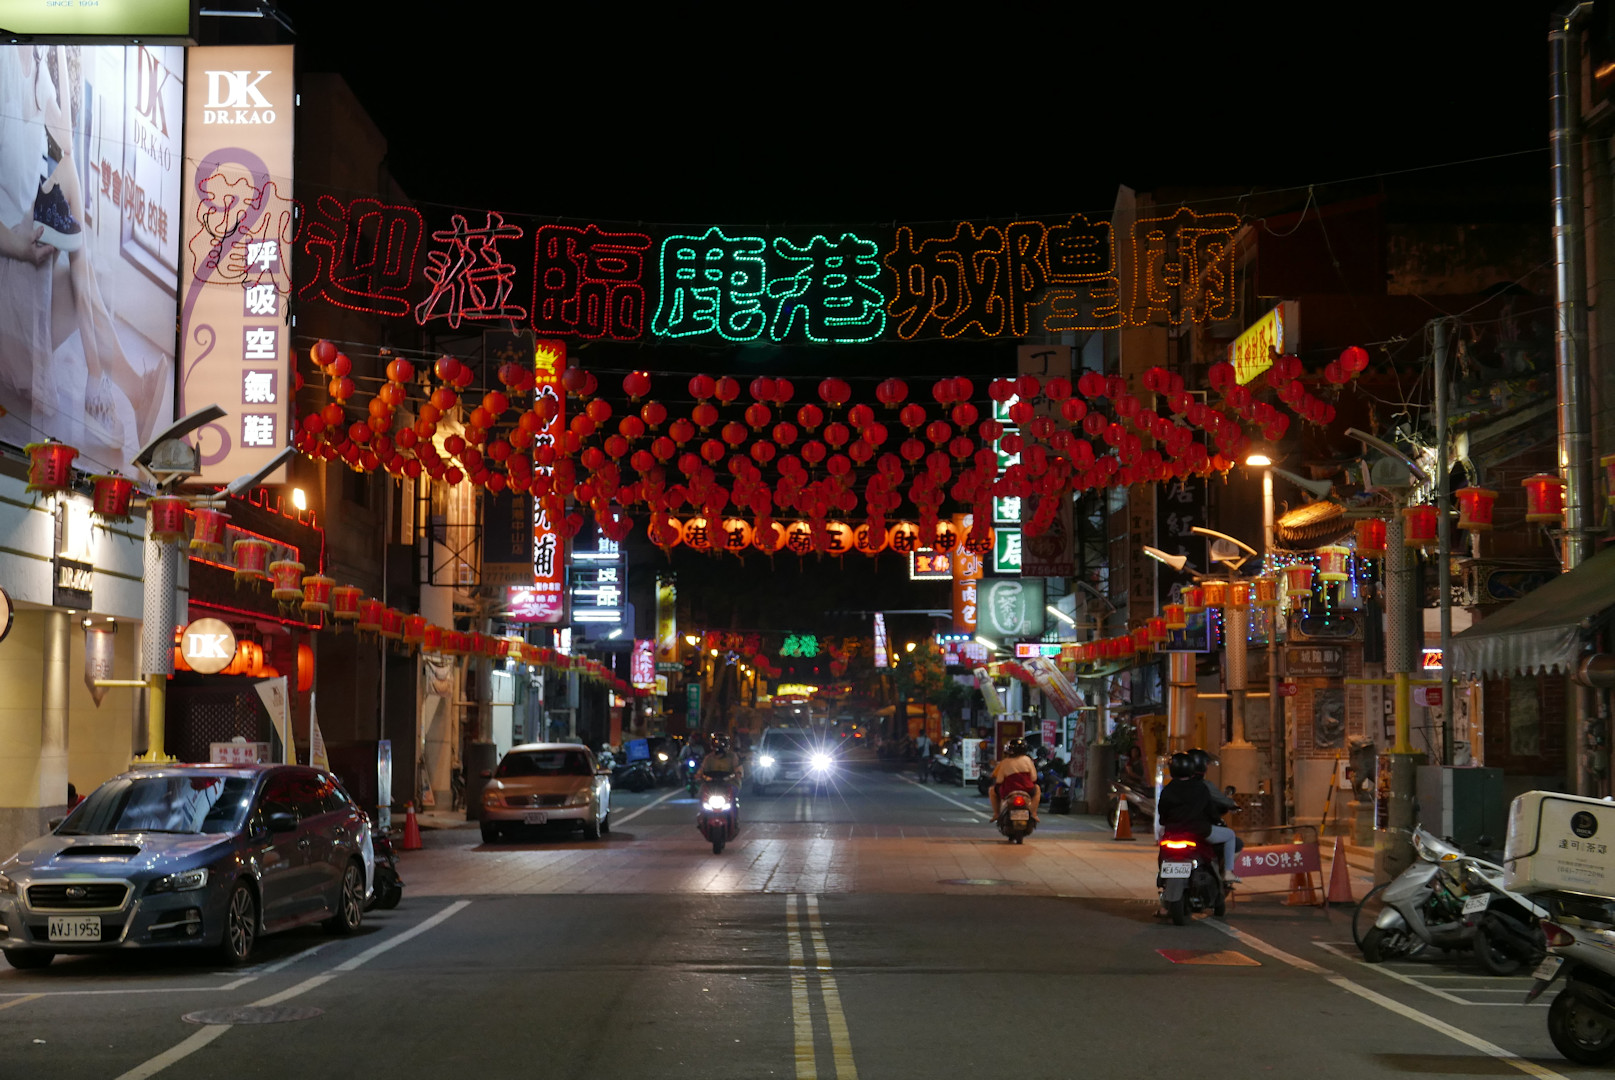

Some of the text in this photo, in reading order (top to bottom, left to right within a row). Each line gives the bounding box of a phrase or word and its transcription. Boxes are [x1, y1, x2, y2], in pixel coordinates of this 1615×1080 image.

[135, 45, 170, 139] DK
[203, 70, 273, 109] DK
[203, 109, 277, 125] DR.KAO
[134, 118, 171, 172] DR.KAO
[90, 156, 168, 243] 一雙會呼吸的鞋
[242, 240, 279, 446] 呼吸空氣鞋
[187, 633, 230, 659] DK
